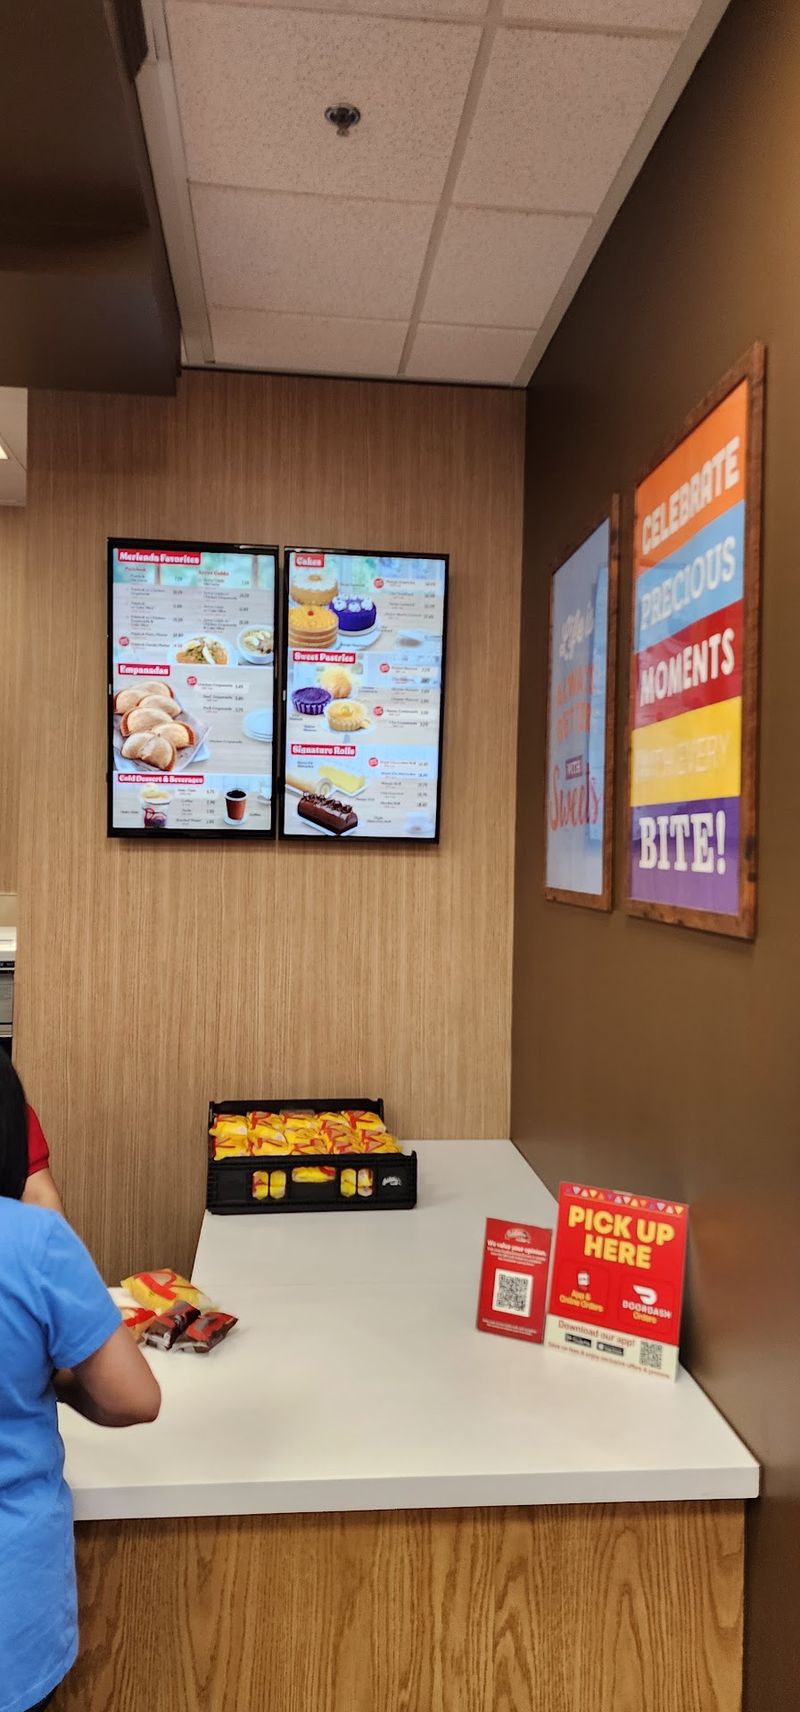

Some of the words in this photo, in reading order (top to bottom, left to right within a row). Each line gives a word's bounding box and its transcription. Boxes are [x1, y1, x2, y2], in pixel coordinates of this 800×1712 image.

[641, 435, 740, 556] CELEBRATE
[119, 552, 159, 562] Merienda
[160, 554, 199, 564] Favorites
[296, 556, 322, 567] Cakes
[640, 536, 737, 631] PRECIOUS
[294, 652, 319, 661] Sweet
[320, 653, 354, 663] Pastries
[119, 665, 169, 676] Empanadas
[639, 627, 735, 708] MOMENTS
[292, 745, 333, 756] Signature
[334, 746, 355, 756] Rolls
[136, 775, 162, 783] Dessert
[169, 776, 203, 784] Beverages
[551, 765, 599, 832] Sweets
[638, 810, 726, 875] BITE!
[568, 1204, 631, 1239] PICK
[636, 1218, 675, 1246] UP
[487, 1239, 497, 1248] We
[584, 1235, 652, 1270] HERE
[559, 1294, 580, 1307] Online
[580, 1300, 604, 1313] Orders
[622, 1300, 672, 1320] DOORDASH
[633, 1311, 657, 1324] Orders
[558, 1320, 599, 1338] Download
[600, 1331, 616, 1341] our
[617, 1335, 635, 1348] app!
